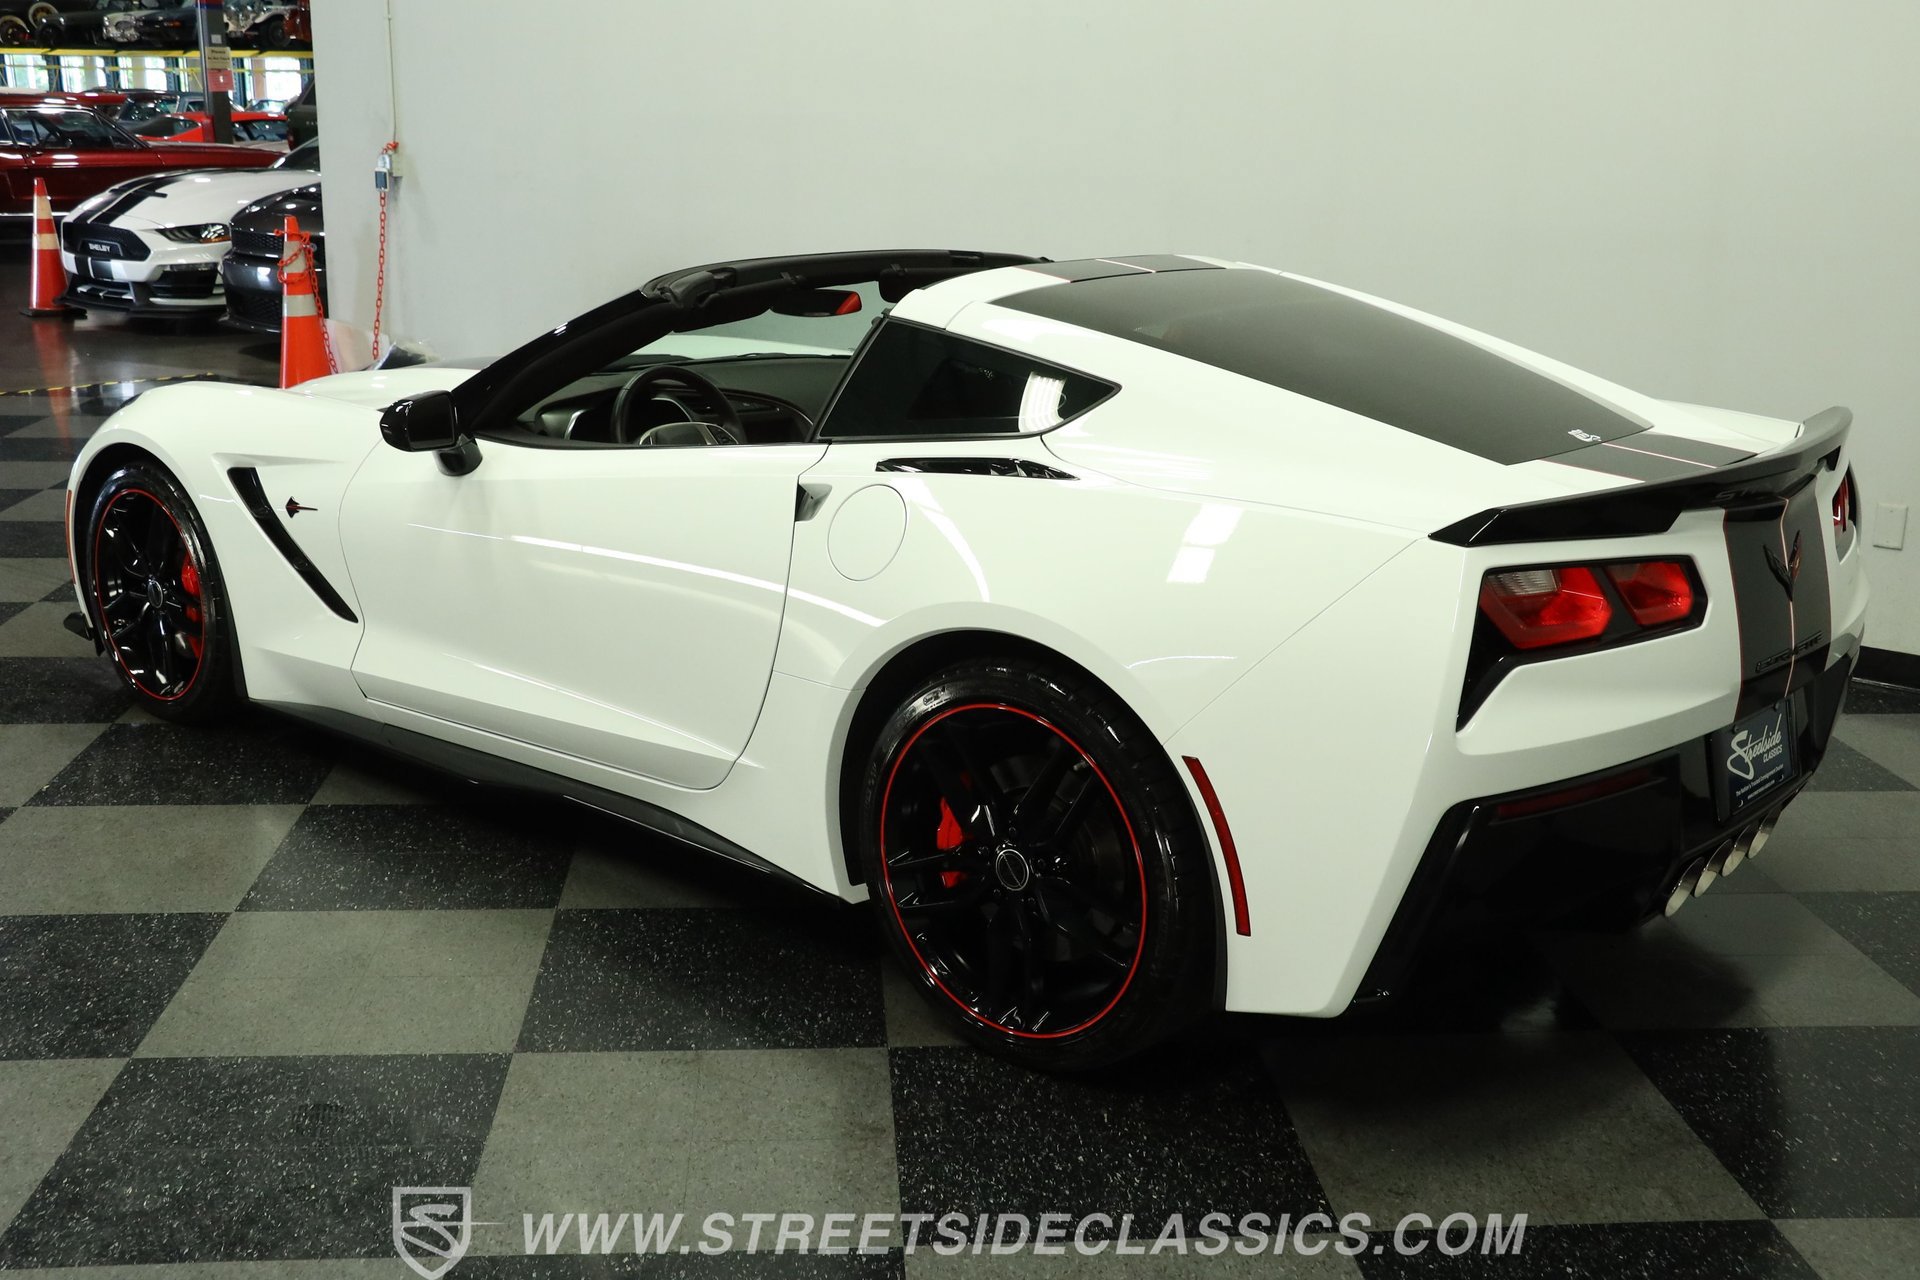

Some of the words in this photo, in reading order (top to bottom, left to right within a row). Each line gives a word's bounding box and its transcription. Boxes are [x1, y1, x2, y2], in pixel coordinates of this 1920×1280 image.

[88, 243, 111, 252] SHELBY
[1726, 713, 1783, 780] Streetside
[1763, 744, 1783, 763] CLASSICS
